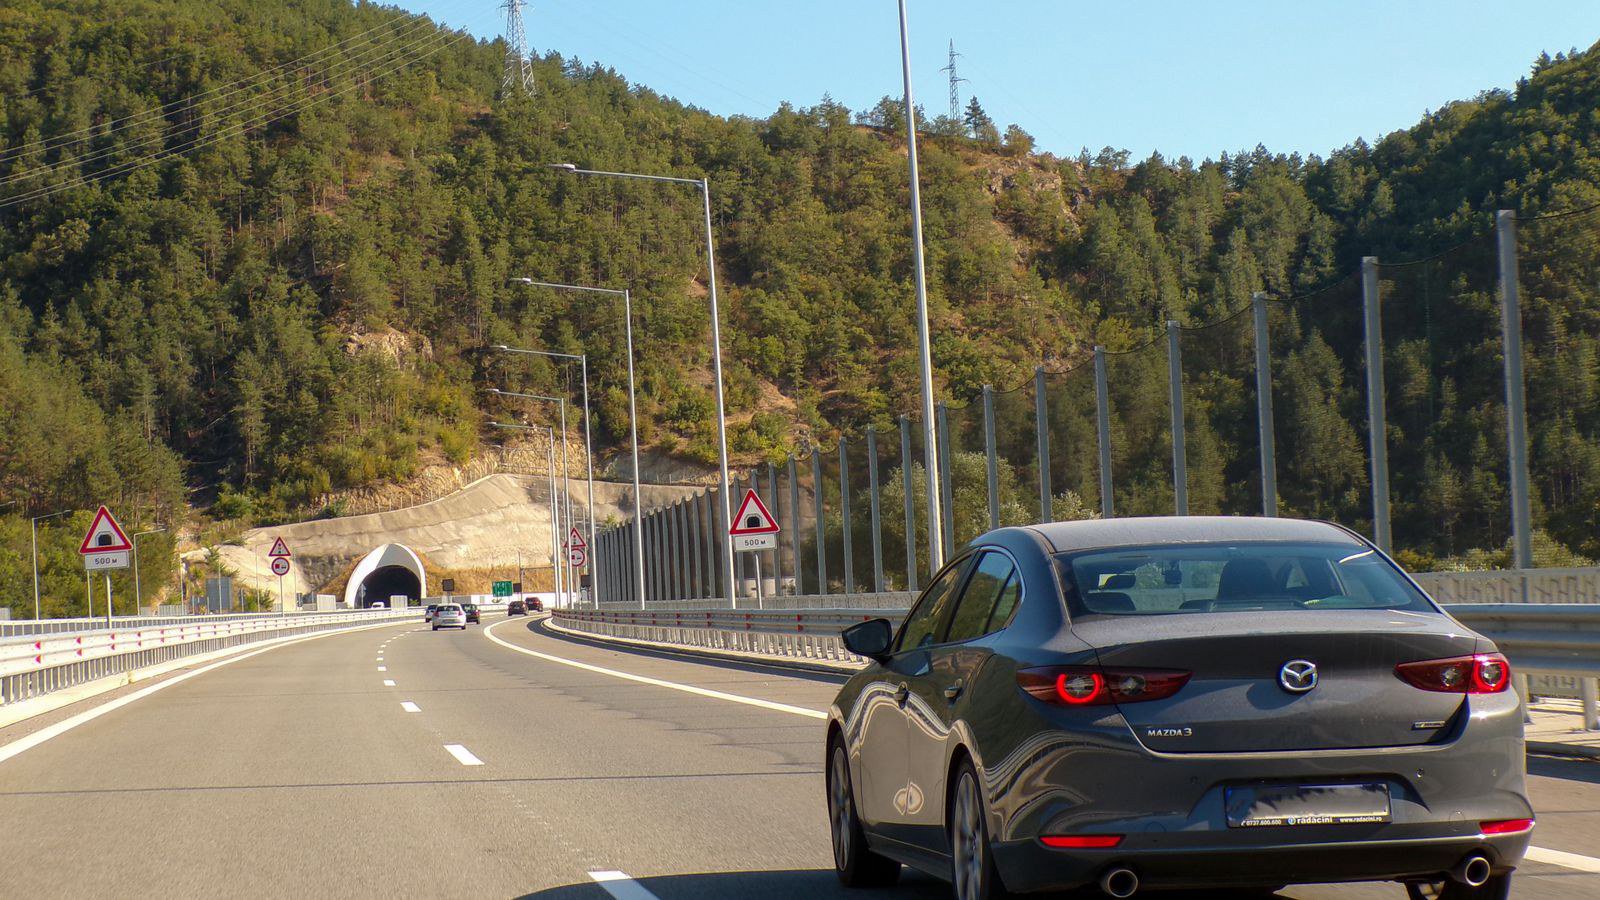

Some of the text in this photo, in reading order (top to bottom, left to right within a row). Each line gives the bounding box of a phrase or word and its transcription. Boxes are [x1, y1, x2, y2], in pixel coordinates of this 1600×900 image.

[744, 539, 759, 547] 500
[94, 557, 110, 565] 500
[1147, 727, 1193, 737] MAZDA 3
